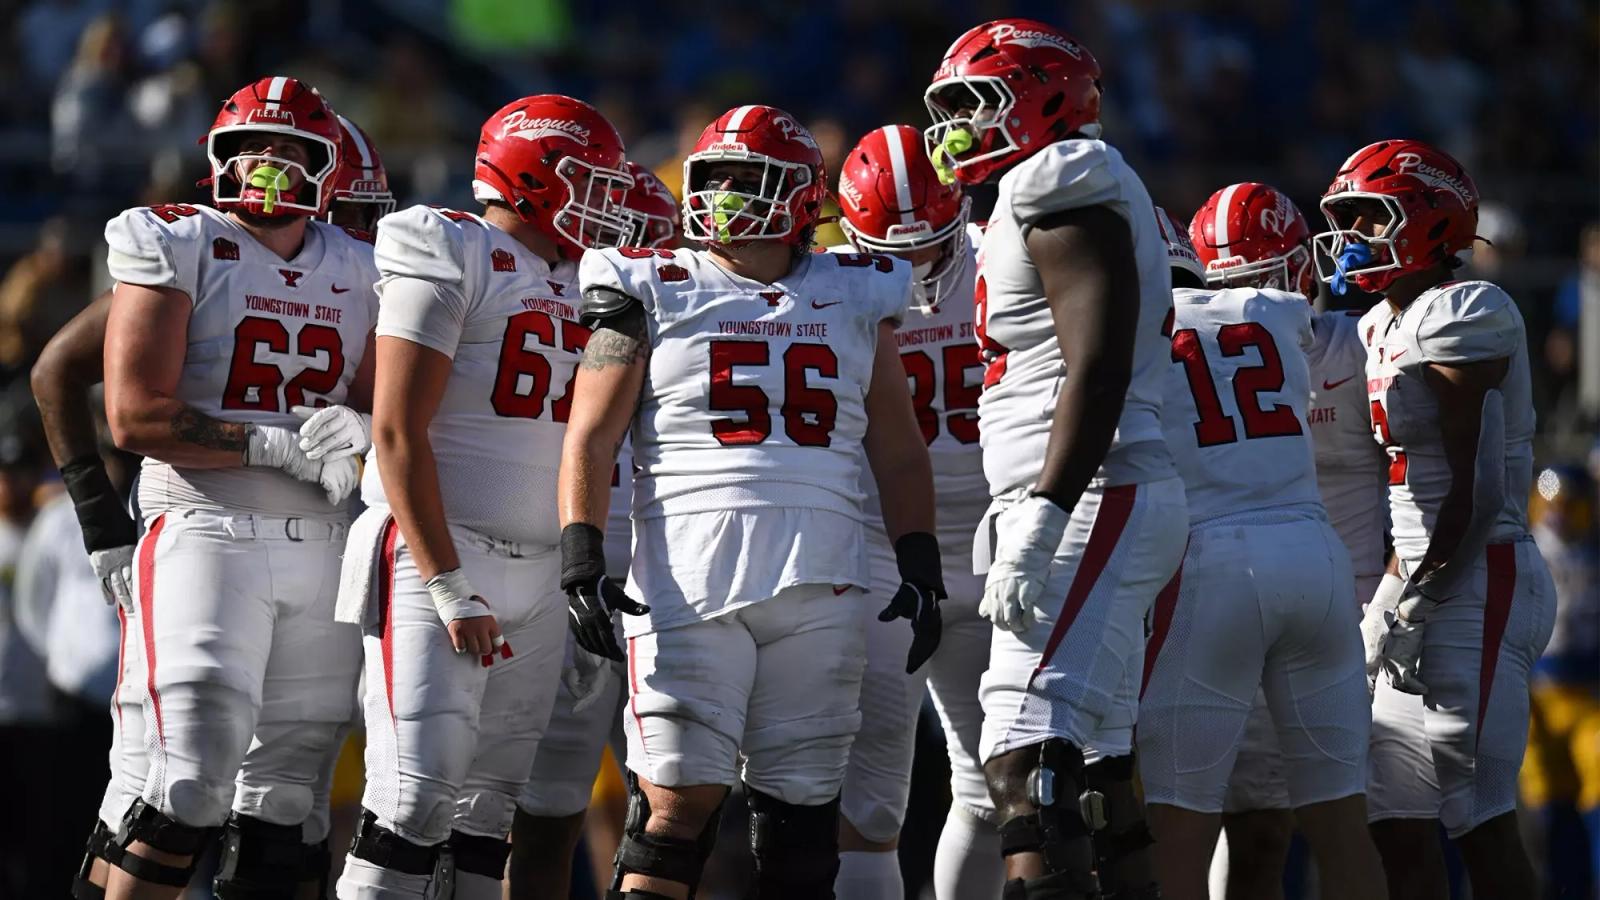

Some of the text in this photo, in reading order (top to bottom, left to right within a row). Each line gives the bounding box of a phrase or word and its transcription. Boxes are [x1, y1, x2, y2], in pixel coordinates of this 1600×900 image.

[988, 24, 1081, 60] Penguins
[501, 111, 591, 146] Penguins
[1395, 153, 1474, 210] Penguins
[893, 223, 926, 235] Riddell
[1210, 259, 1243, 270] Riddell
[245, 294, 343, 324] YOUNGSTOWN STATE
[521, 298, 575, 320] YOUNGSTOWN
[718, 321, 828, 337] YOUNGSTOWN STATE
[221, 315, 345, 414] 62
[709, 340, 838, 447] 56
[1171, 322, 1303, 448] 12
